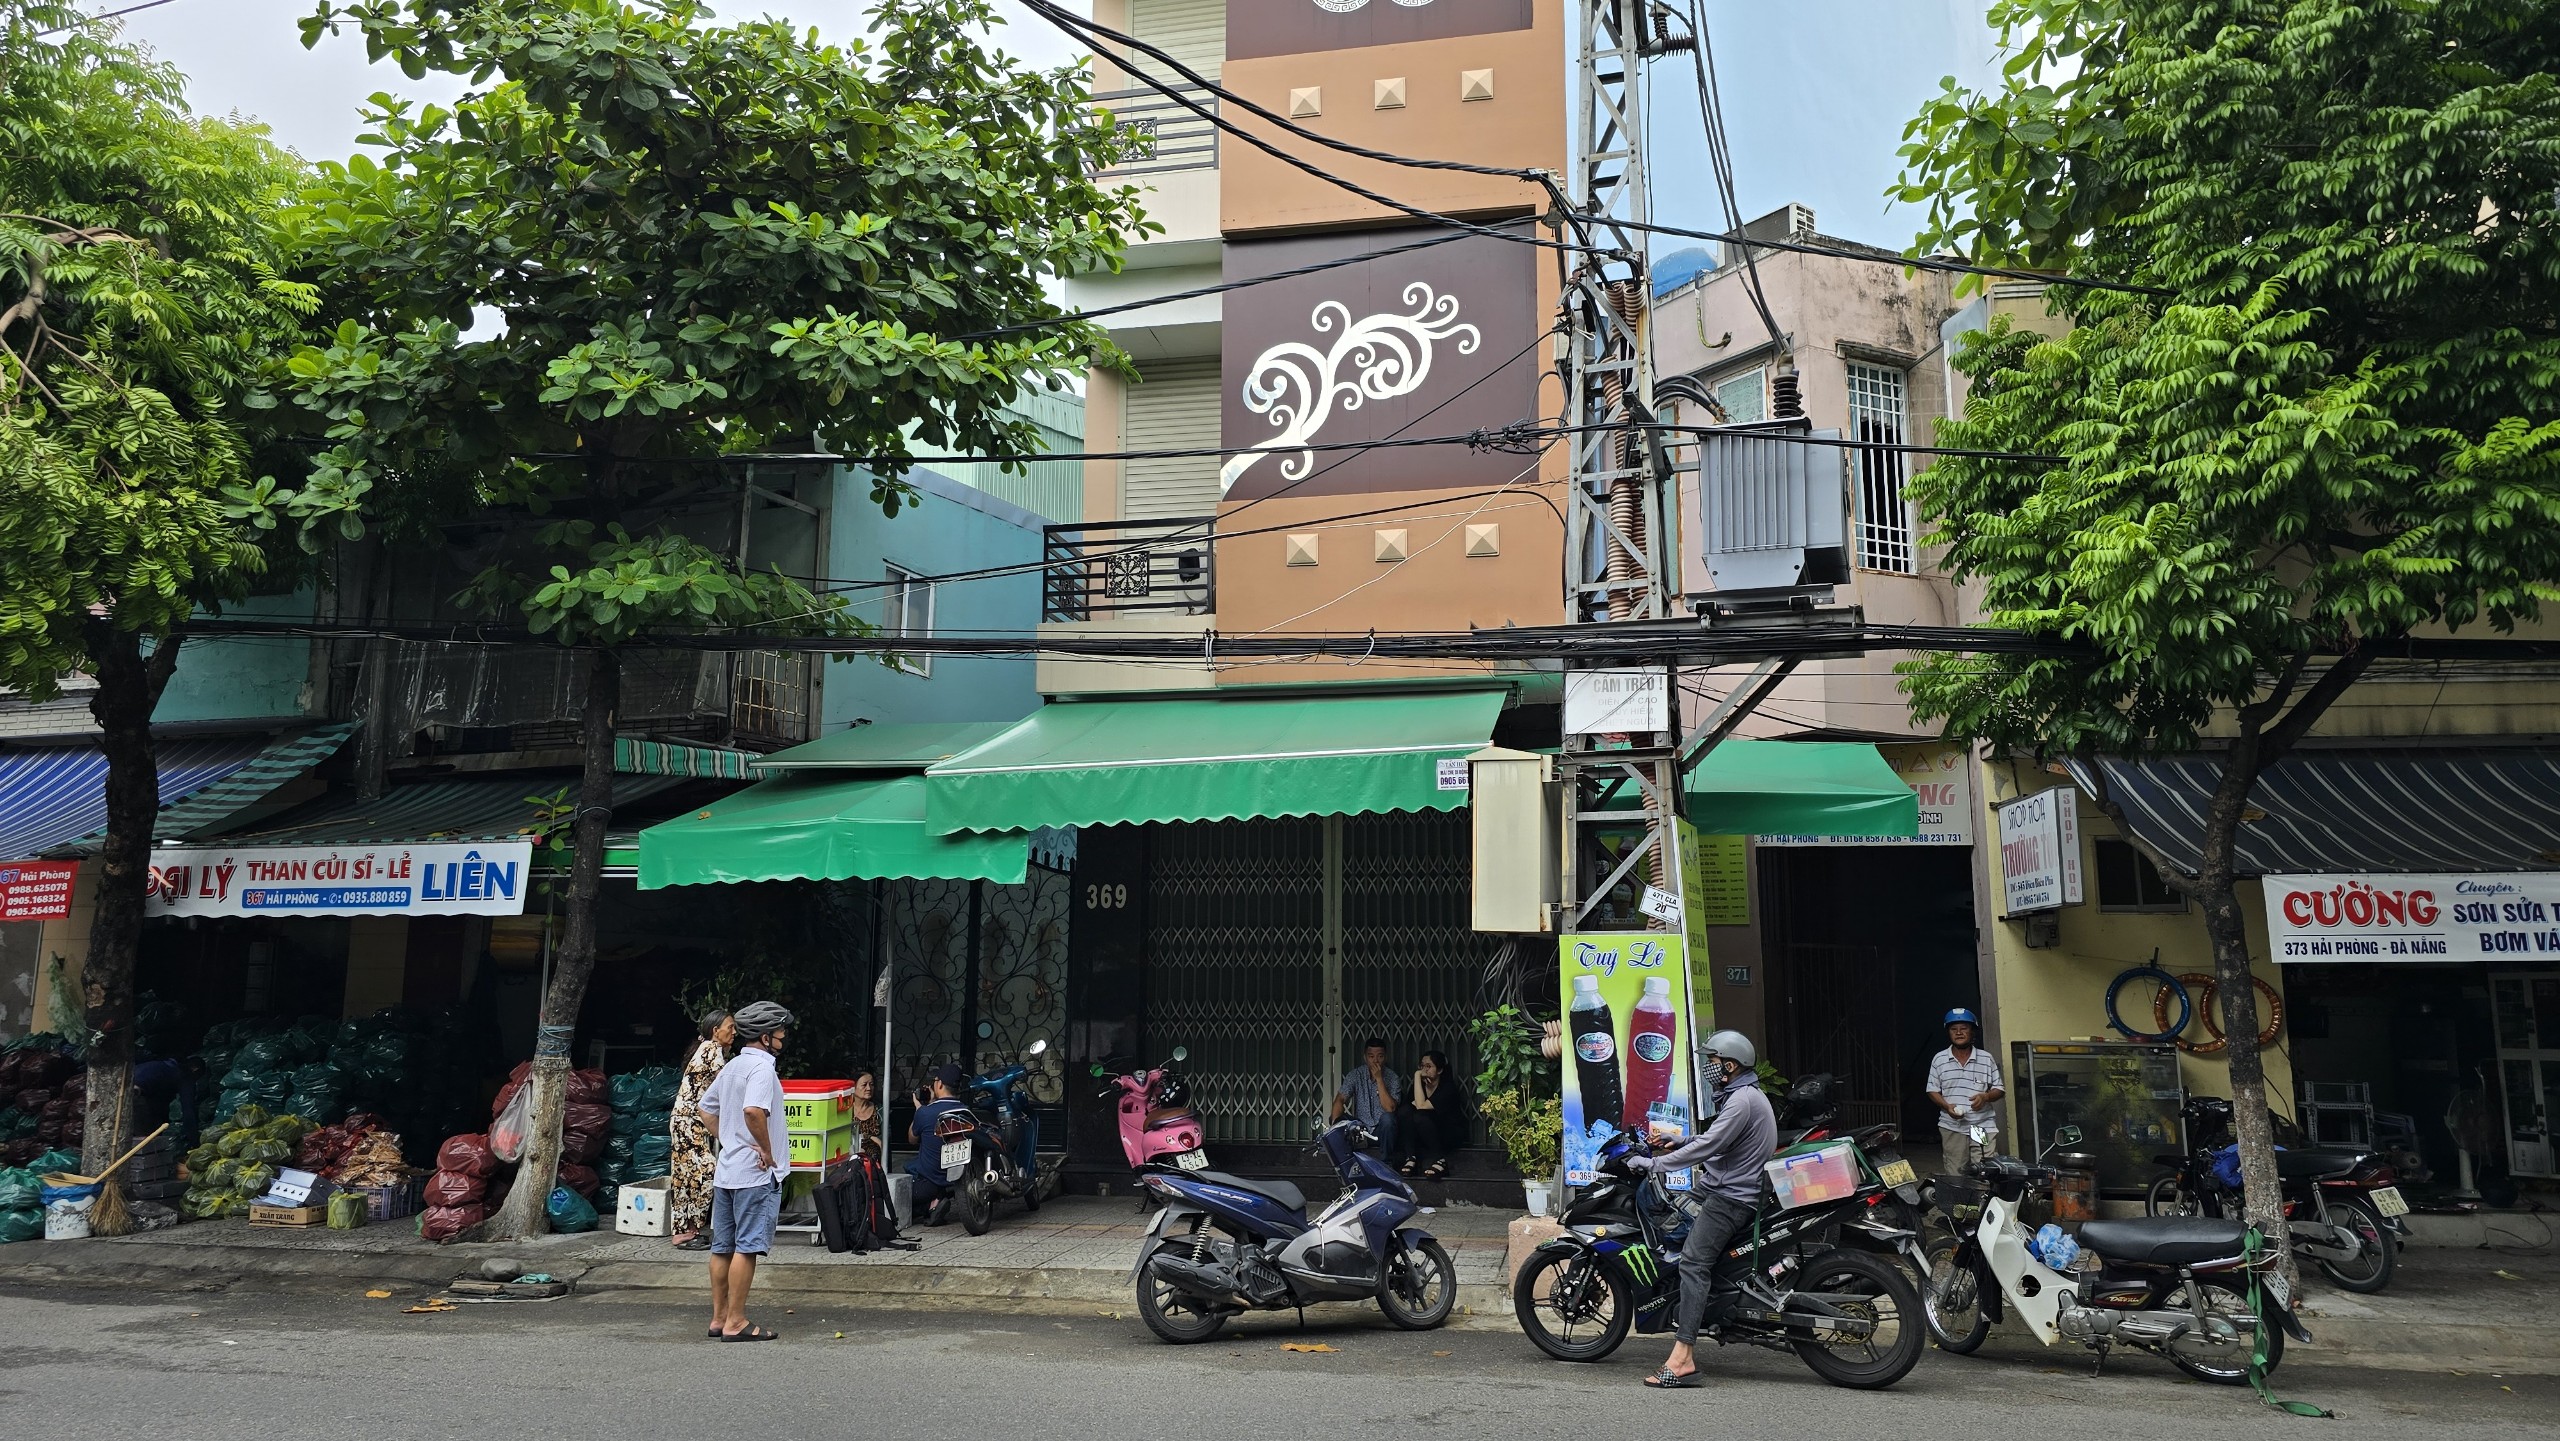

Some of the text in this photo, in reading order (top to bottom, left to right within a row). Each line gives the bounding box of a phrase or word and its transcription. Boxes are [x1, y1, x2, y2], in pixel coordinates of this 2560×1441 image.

[1458, 776, 1468, 785] 66
[1760, 834, 1773, 843] 371
[1931, 833, 1945, 842] 231
[1948, 833, 1962, 842] 731
[2062, 794, 2078, 897] SHOP HOA
[246, 859, 307, 881] THAN
[312, 852, 347, 880] CỦI
[351, 853, 375, 879] SĨ
[387, 851, 411, 879] LẺ
[0, 868, 71, 884] 67 Hải Phòng
[199, 857, 238, 903] LÝ
[421, 850, 519, 902] LIÊN
[8, 882, 68, 895] 0988.625078
[246, 891, 265, 905] 367
[266, 890, 283, 905] HẢI
[285, 890, 319, 905] PHÒNG
[1086, 883, 1127, 909] 369
[2455, 880, 2516, 897] Chuyên
[7, 893, 66, 906] 0905.168324
[2283, 880, 2441, 928] CƯỜNG
[5, 904, 66, 917] 0905.264942
[2453, 901, 2499, 924] SƠN
[2503, 896, 2549, 924] SỬA
[2285, 941, 2308, 956] 373
[2311, 937, 2332, 955] HẢI
[2336, 938, 2379, 955] PHÒNG
[2390, 937, 2408, 955] ĐÀ
[2411, 935, 2447, 955] NẴNG
[2479, 930, 2530, 953] BƠM
[1627, 940, 1665, 968] Lê
[1726, 967, 1748, 981] 371
[1580, 1171, 1592, 1181] 369
[1673, 1176, 1686, 1185] 763
[1735, 1238, 1767, 1256] ENES
